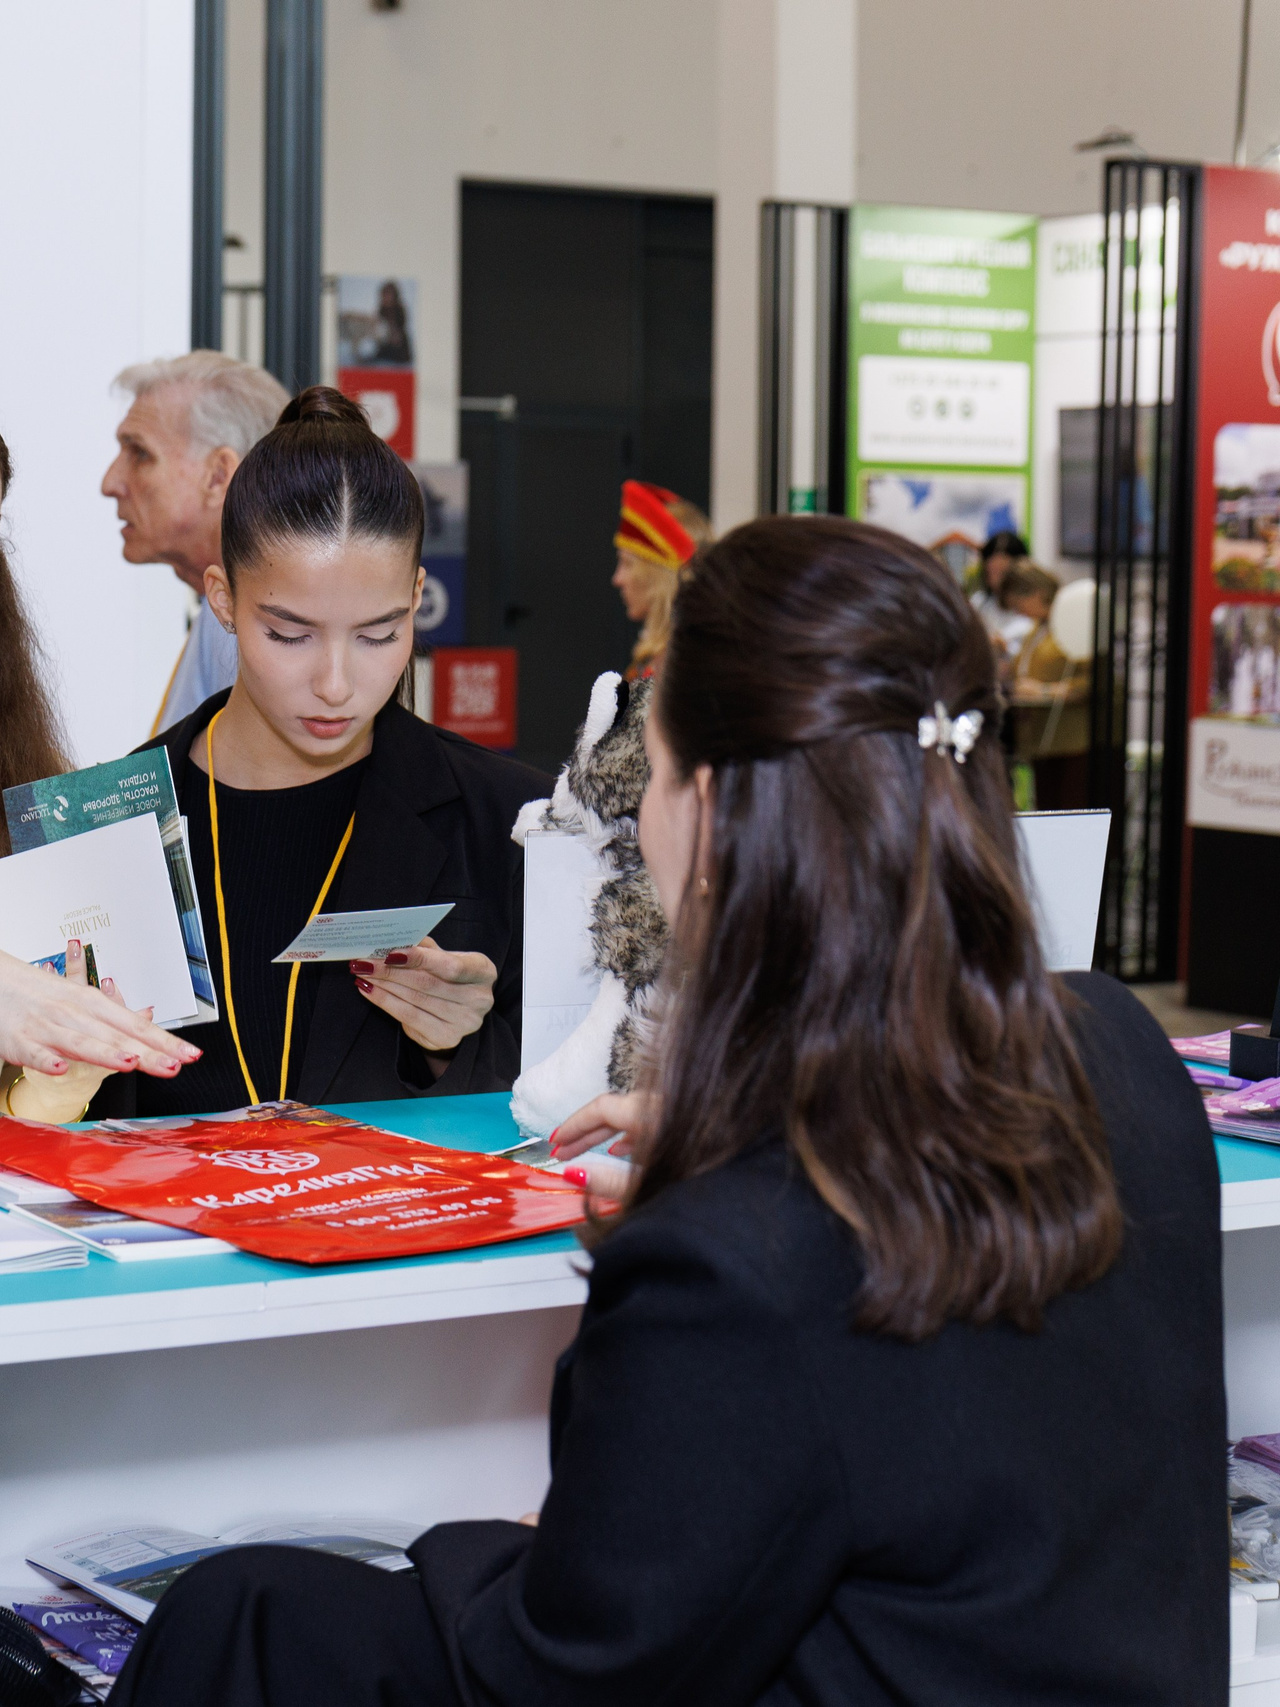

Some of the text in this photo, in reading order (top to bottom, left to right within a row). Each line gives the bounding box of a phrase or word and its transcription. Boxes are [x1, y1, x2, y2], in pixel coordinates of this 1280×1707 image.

[118, 771, 157, 788] И ОТДЫХА
[82, 784, 159, 812] КРАСОТЫ, ЗДОРОВЬЯ
[20, 808, 51, 822] LUCIANO
[92, 797, 162, 824] НОВОЕ ИЗМЕРЕНИЕ
[82, 904, 101, 915] PALACE
[60, 912, 111, 938] PALMIRA
[294, 1187, 428, 1213] Туры по Карелии
[345, 1215, 391, 1227] 800
